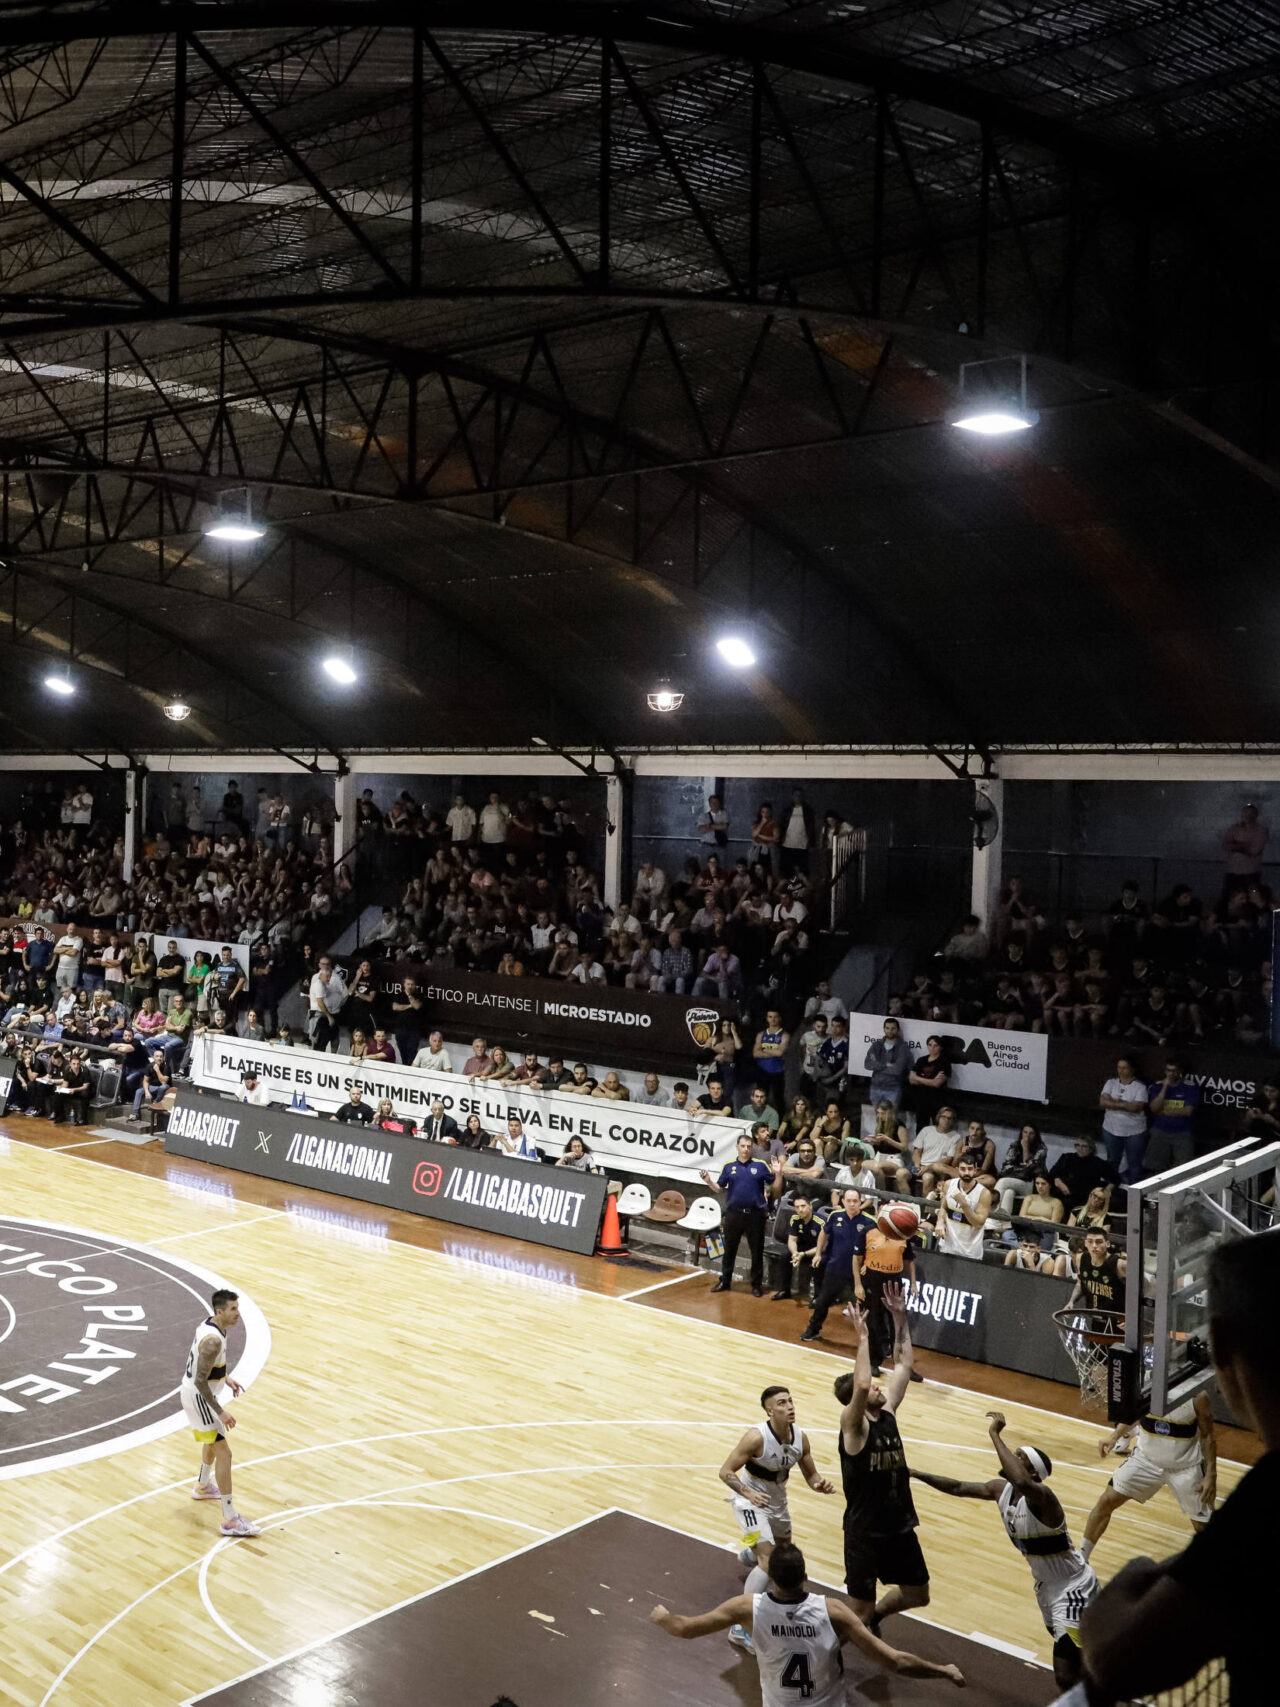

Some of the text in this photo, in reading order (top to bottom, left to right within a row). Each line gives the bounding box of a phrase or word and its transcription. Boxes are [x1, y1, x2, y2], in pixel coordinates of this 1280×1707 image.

[426, 985, 463, 1003] ÉTICO
[466, 991, 532, 1012] PLATENSE
[544, 1002, 652, 1028] MICROESTADIO
[987, 1041, 1023, 1053] Buenos
[992, 1050, 1019, 1061] Aires
[995, 1059, 1030, 1071] Ciudad
[220, 1054, 716, 1158] PLATENSE ES UN SENTIMIENTO SE LLEVA EN EL CORAZÓN
[285, 1132, 393, 1185] /LIGANACIONAL
[443, 1167, 586, 1228] /LALIGABASQUET
[1112, 1359, 1122, 1403] STADIUM
[771, 1624, 816, 1638] MAINOLDI
[780, 1651, 816, 1699] 4
